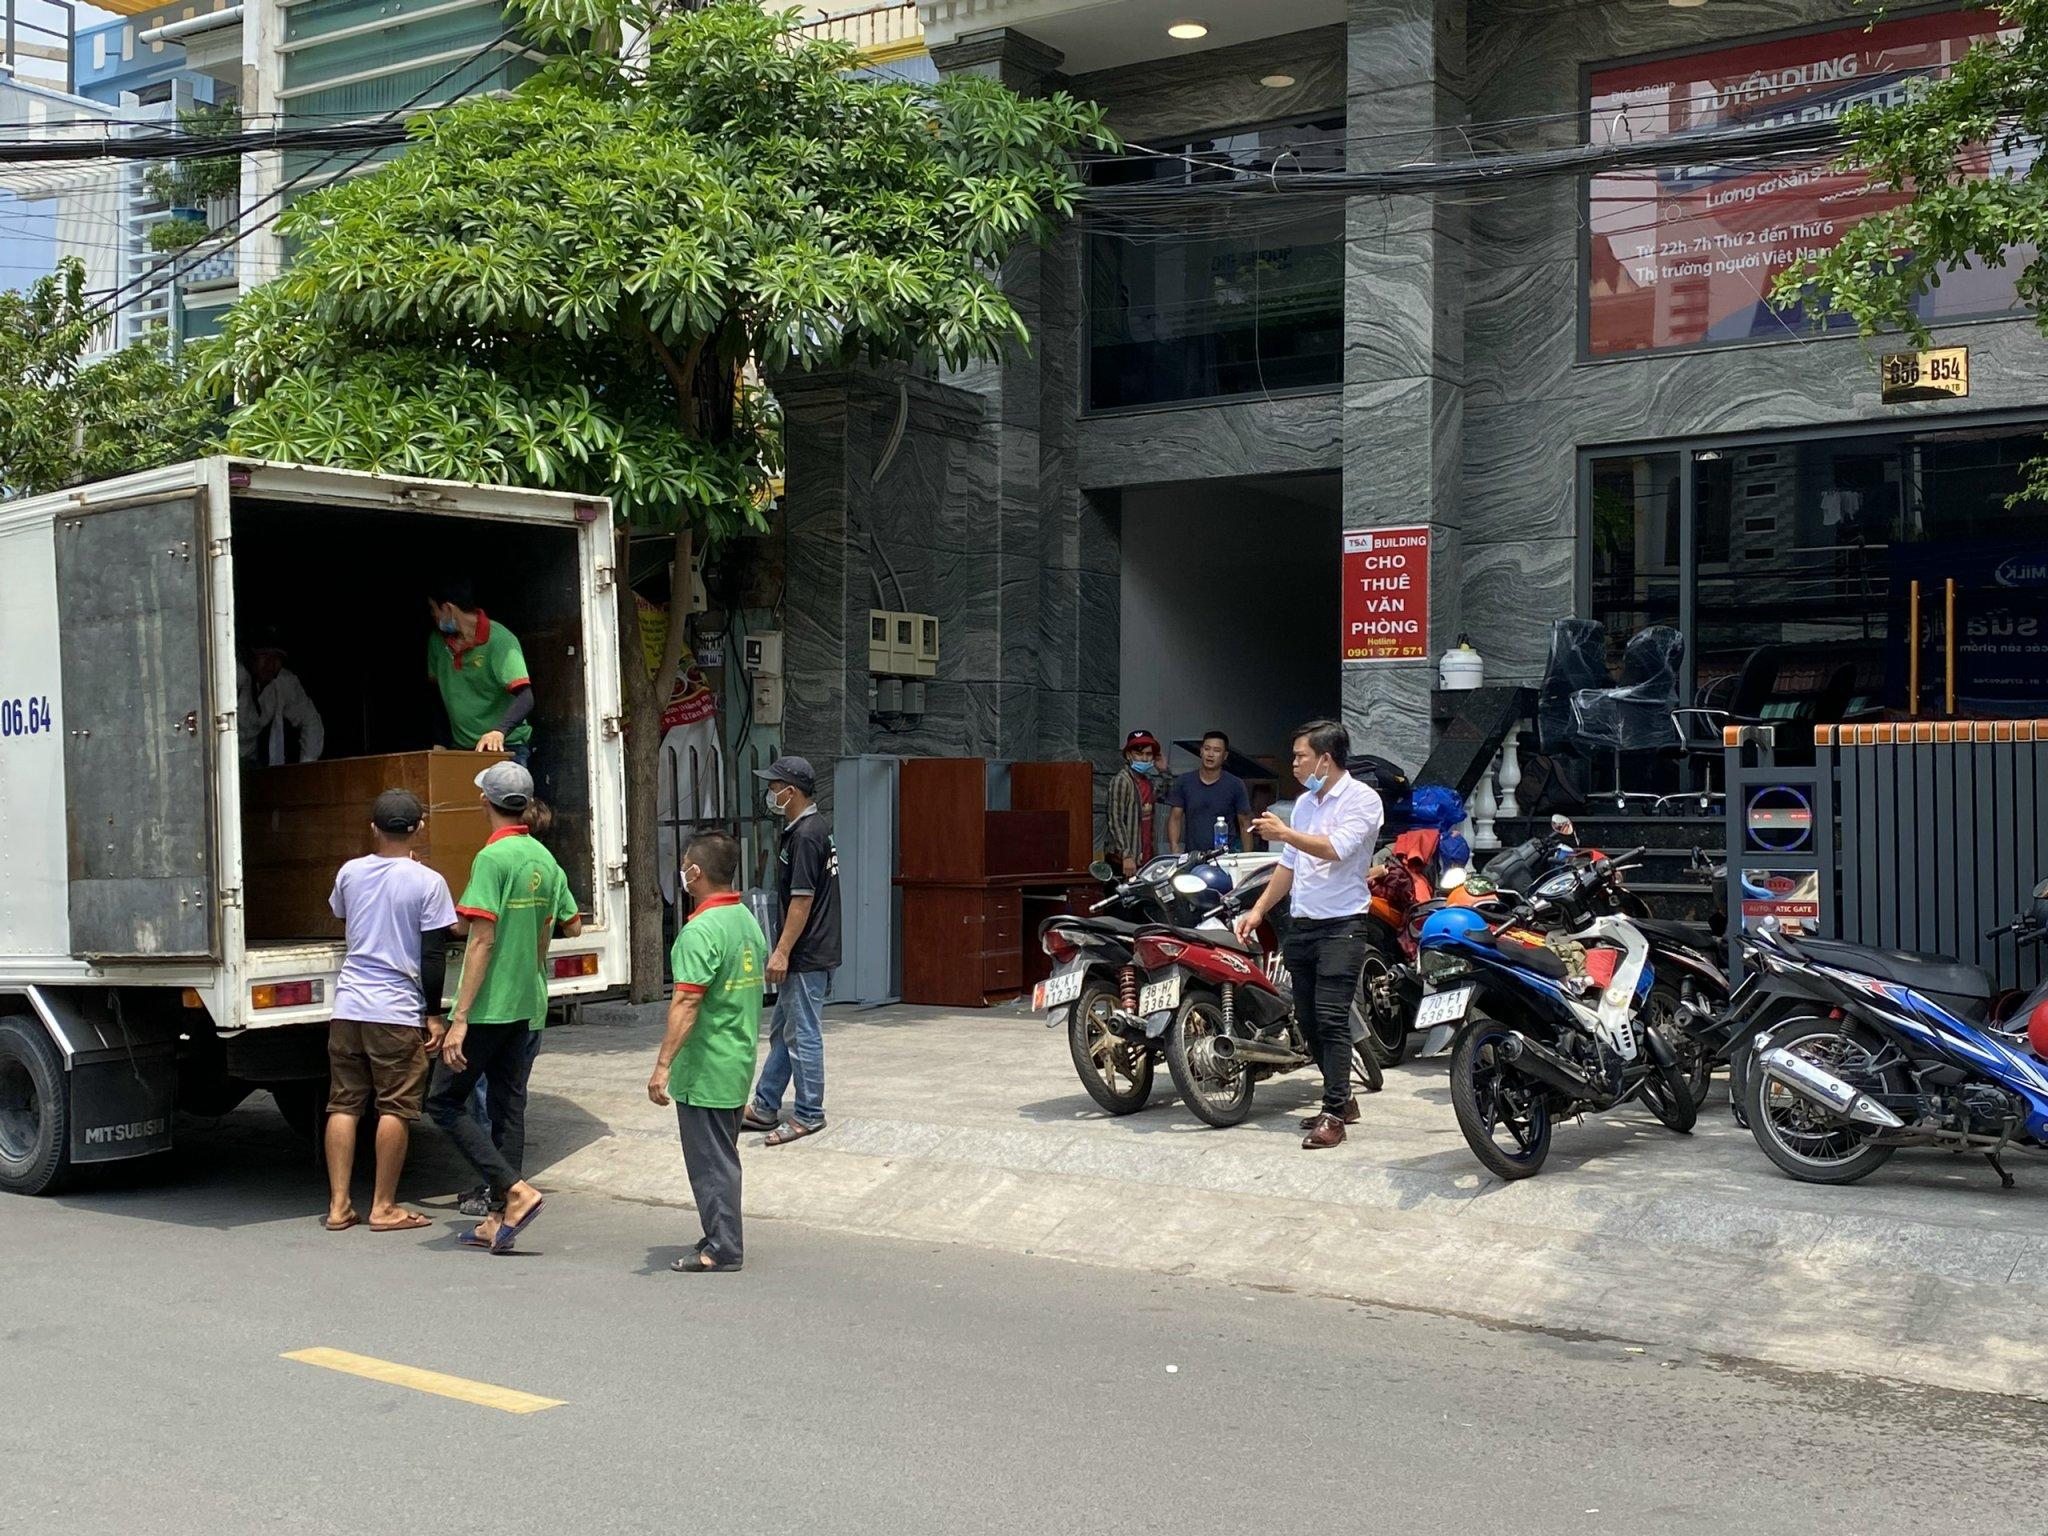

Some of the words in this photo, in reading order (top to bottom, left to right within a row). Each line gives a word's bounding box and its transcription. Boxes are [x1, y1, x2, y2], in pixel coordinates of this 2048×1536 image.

[1781, 53, 1858, 93] DỤNG
[1635, 81, 1677, 98] GROUP
[1705, 185, 1755, 208] Lương
[1757, 177, 1780, 196] cơ
[1778, 170, 1809, 189] bản
[1659, 237, 1712, 257] 22h-7h
[1714, 231, 1745, 249] Thứ
[1746, 231, 1756, 246] 2
[1759, 225, 1788, 243] đến
[1790, 222, 1822, 239] Thứ
[1823, 222, 1834, 236] 6
[1662, 261, 1713, 279] trường
[1715, 252, 1760, 274] người
[1762, 251, 1793, 268] Việt
[1796, 246, 1833, 262] Nam
[1931, 357, 1961, 381] B54
[1374, 535, 1427, 549] BUILDING
[1365, 554, 1406, 570] CHO
[1360, 573, 1411, 592] THUÊ
[1366, 596, 1405, 613] VĂN
[1351, 617, 1419, 635] PHÒNG
[1367, 637, 1397, 646] Hotline
[1347, 648, 1374, 658] 0901
[1378, 647, 1400, 657] 377
[1402, 646, 1423, 656] 571
[2, 696, 51, 737] 06.64
[1748, 905, 1792, 913] AUTOATIC
[1793, 905, 1812, 913] GATE
[1145, 980, 1174, 998] 38-H7
[1144, 995, 1172, 1013] 3362
